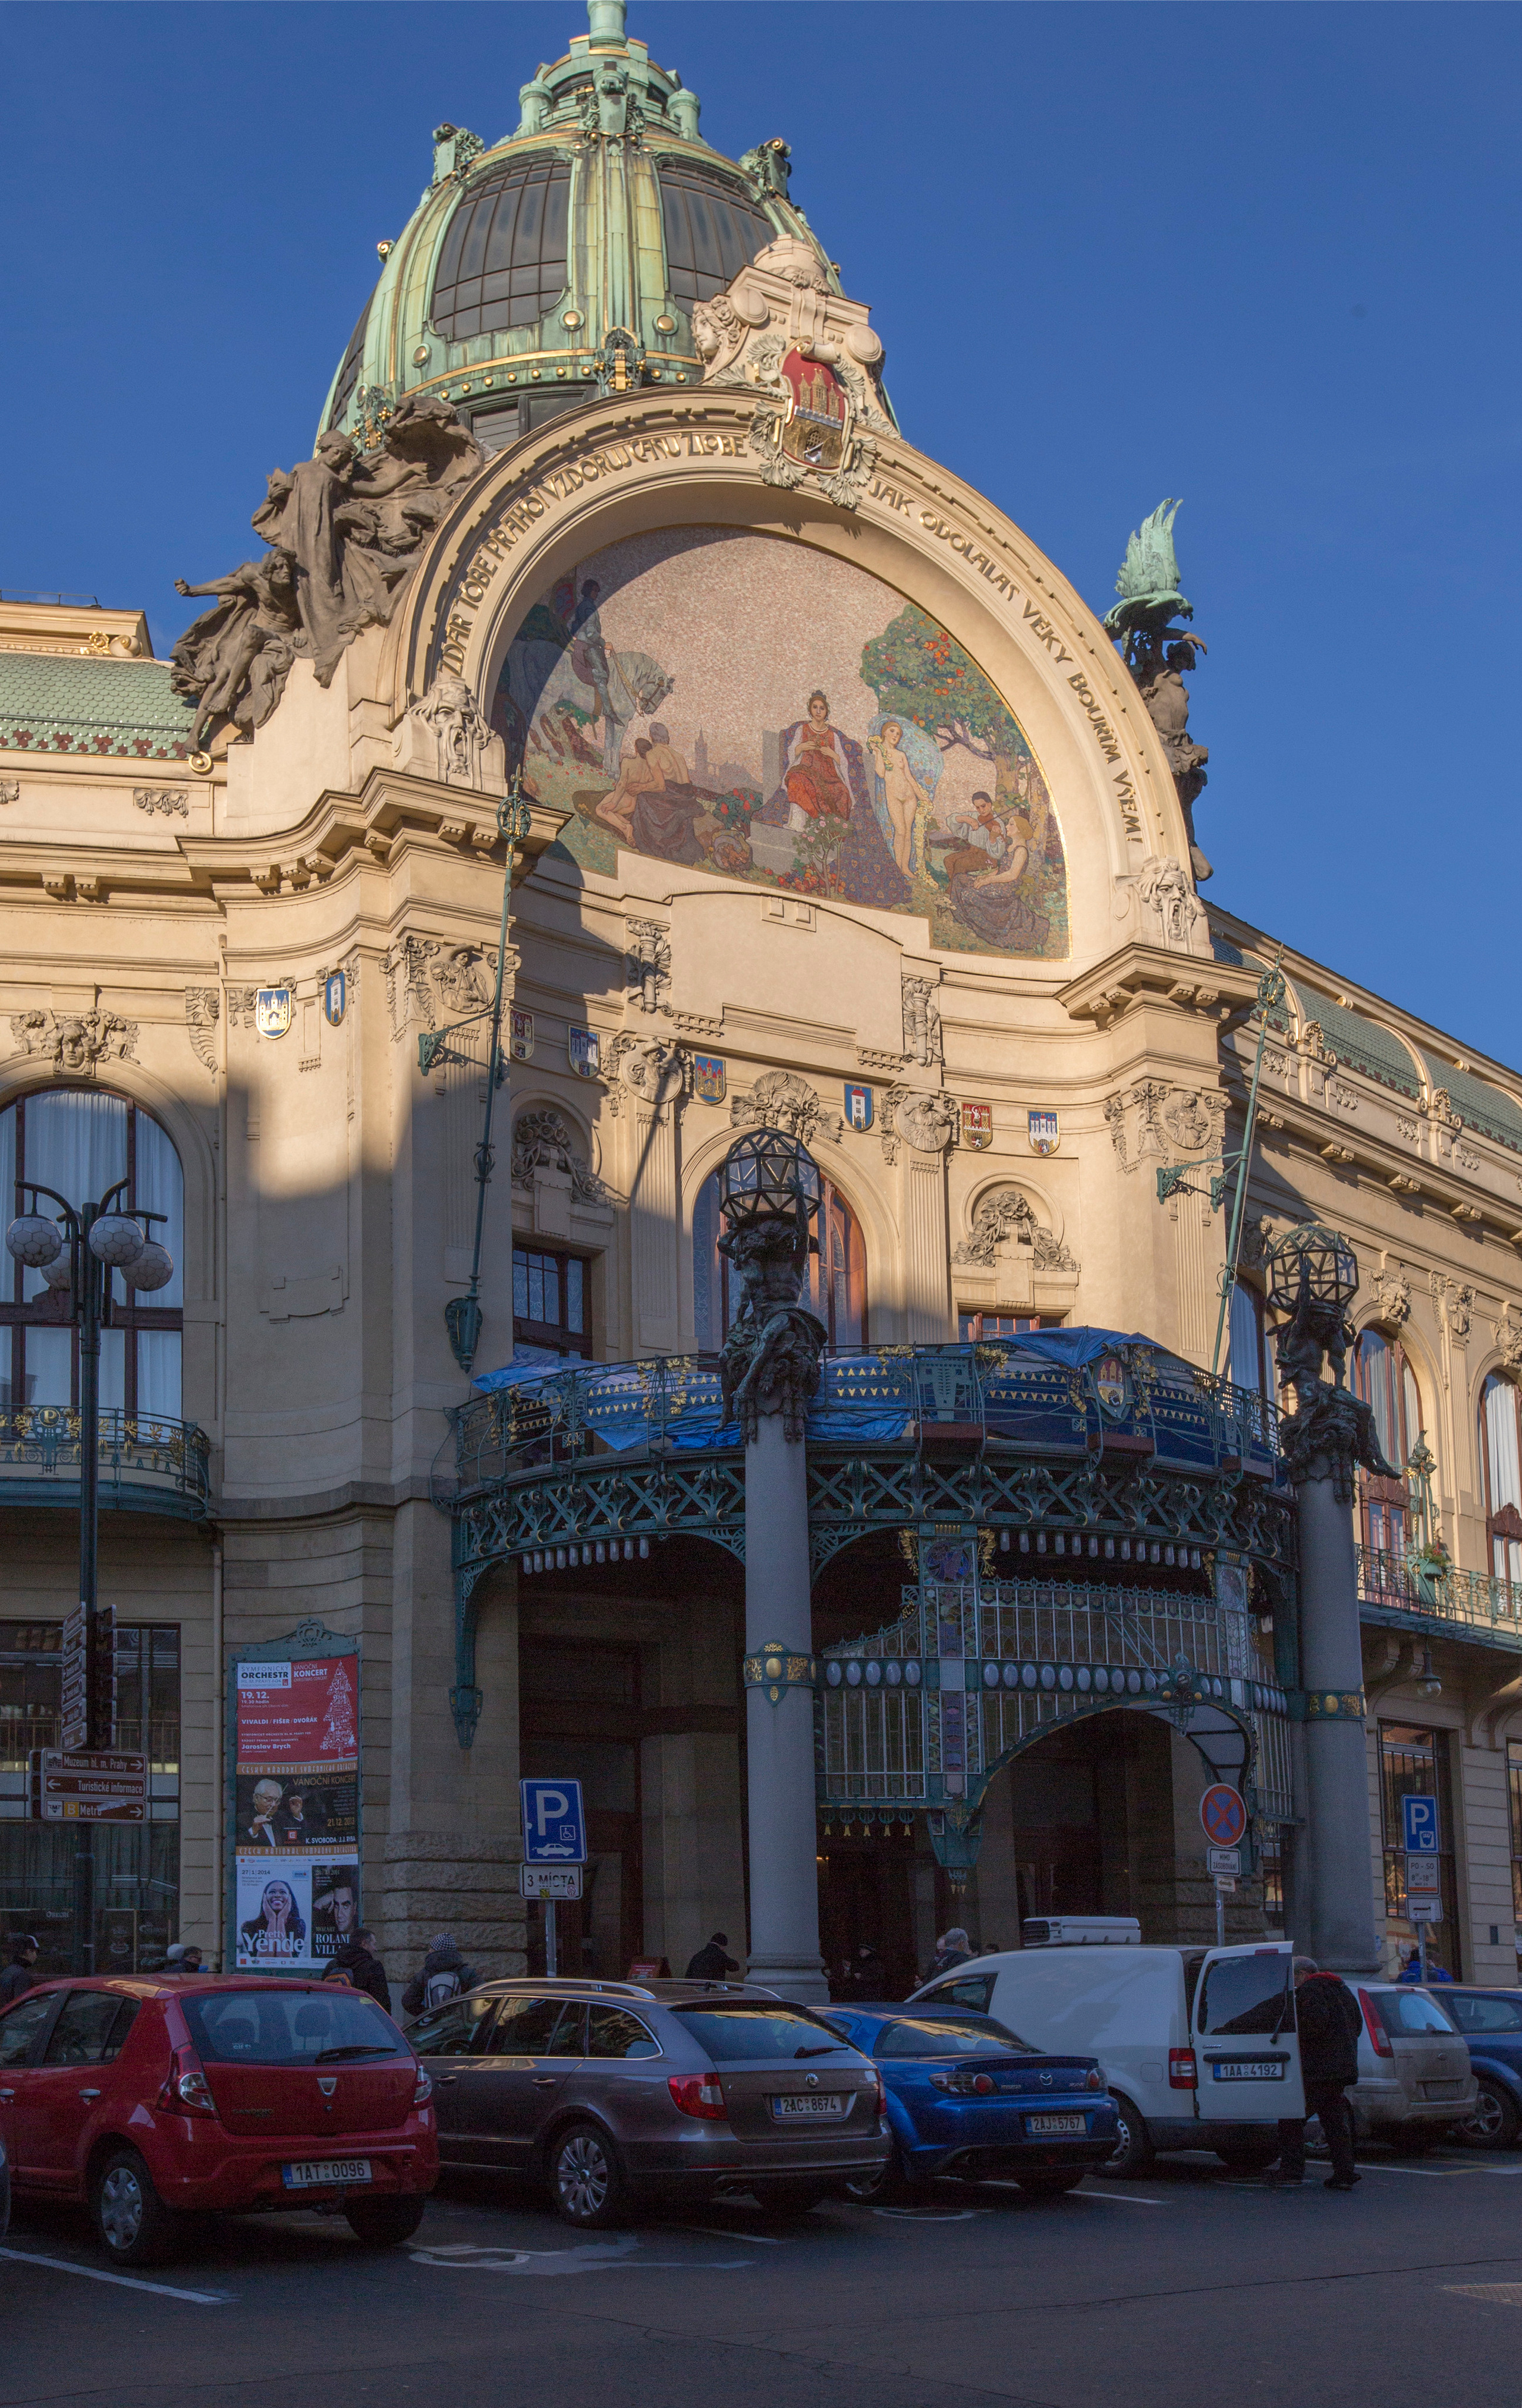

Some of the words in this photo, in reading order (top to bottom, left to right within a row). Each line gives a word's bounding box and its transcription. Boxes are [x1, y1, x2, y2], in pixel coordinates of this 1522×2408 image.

[868, 480, 915, 518] JAK
[919, 511, 1020, 602] ODOLALAS
[436, 614, 473, 677] ZDAR
[294, 1668, 328, 1677] KONCERT
[64, 1756, 89, 1768] Muzeum
[110, 1758, 127, 1772] Prahy
[331, 1774, 356, 1784] KONCERT
[77, 1780, 109, 1793] Turistické
[111, 1781, 143, 1794] informace
[67, 1804, 76, 1815] B
[536, 1790, 569, 1836] P
[1410, 1803, 1429, 1835] P
[527, 1875, 534, 1887] 3
[258, 1929, 285, 1939] Pretty
[242, 1932, 305, 1953] Yende
[315, 1945, 341, 1954] VILL
[1224, 2065, 1242, 2077] 1AA
[1250, 2064, 1277, 2076] 4192
[784, 2098, 803, 2112] 2AC
[812, 2096, 837, 2111] 8674
[1034, 2118, 1051, 2130] 2AJ
[1058, 2116, 1080, 2129] 5767
[296, 2165, 320, 2180] 1AT
[332, 2162, 365, 2178] 0096
